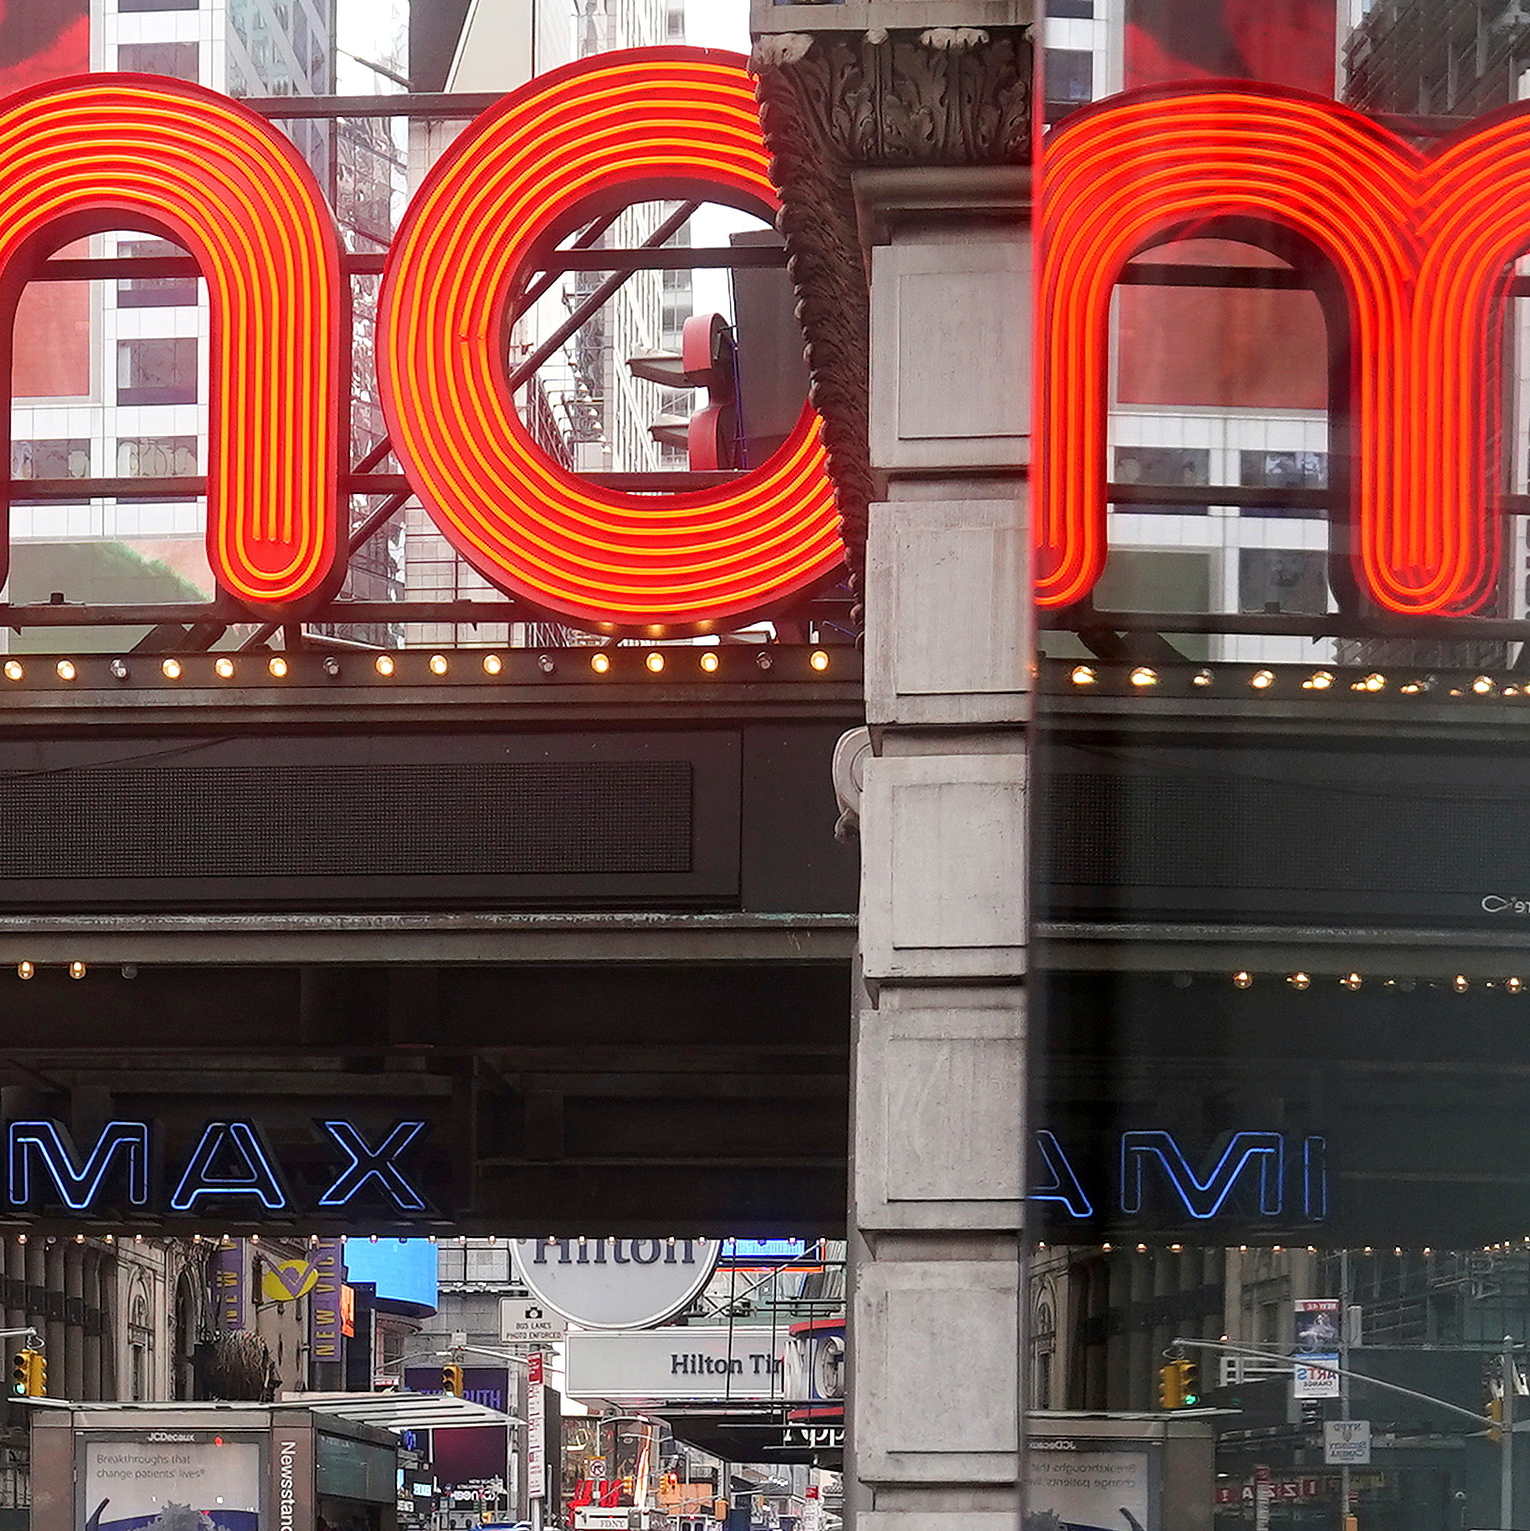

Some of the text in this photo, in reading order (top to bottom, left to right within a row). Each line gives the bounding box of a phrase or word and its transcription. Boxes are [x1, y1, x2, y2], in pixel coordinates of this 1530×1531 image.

[316, 1309, 336, 1356] NEW
[671, 1354, 743, 1375] Hilton
[146, 1431, 195, 1442] JCDecaux
[96, 1454, 191, 1465] Breakthroughs that
[96, 1469, 133, 1480] change
[601, 1520, 625, 1528] FDNY
